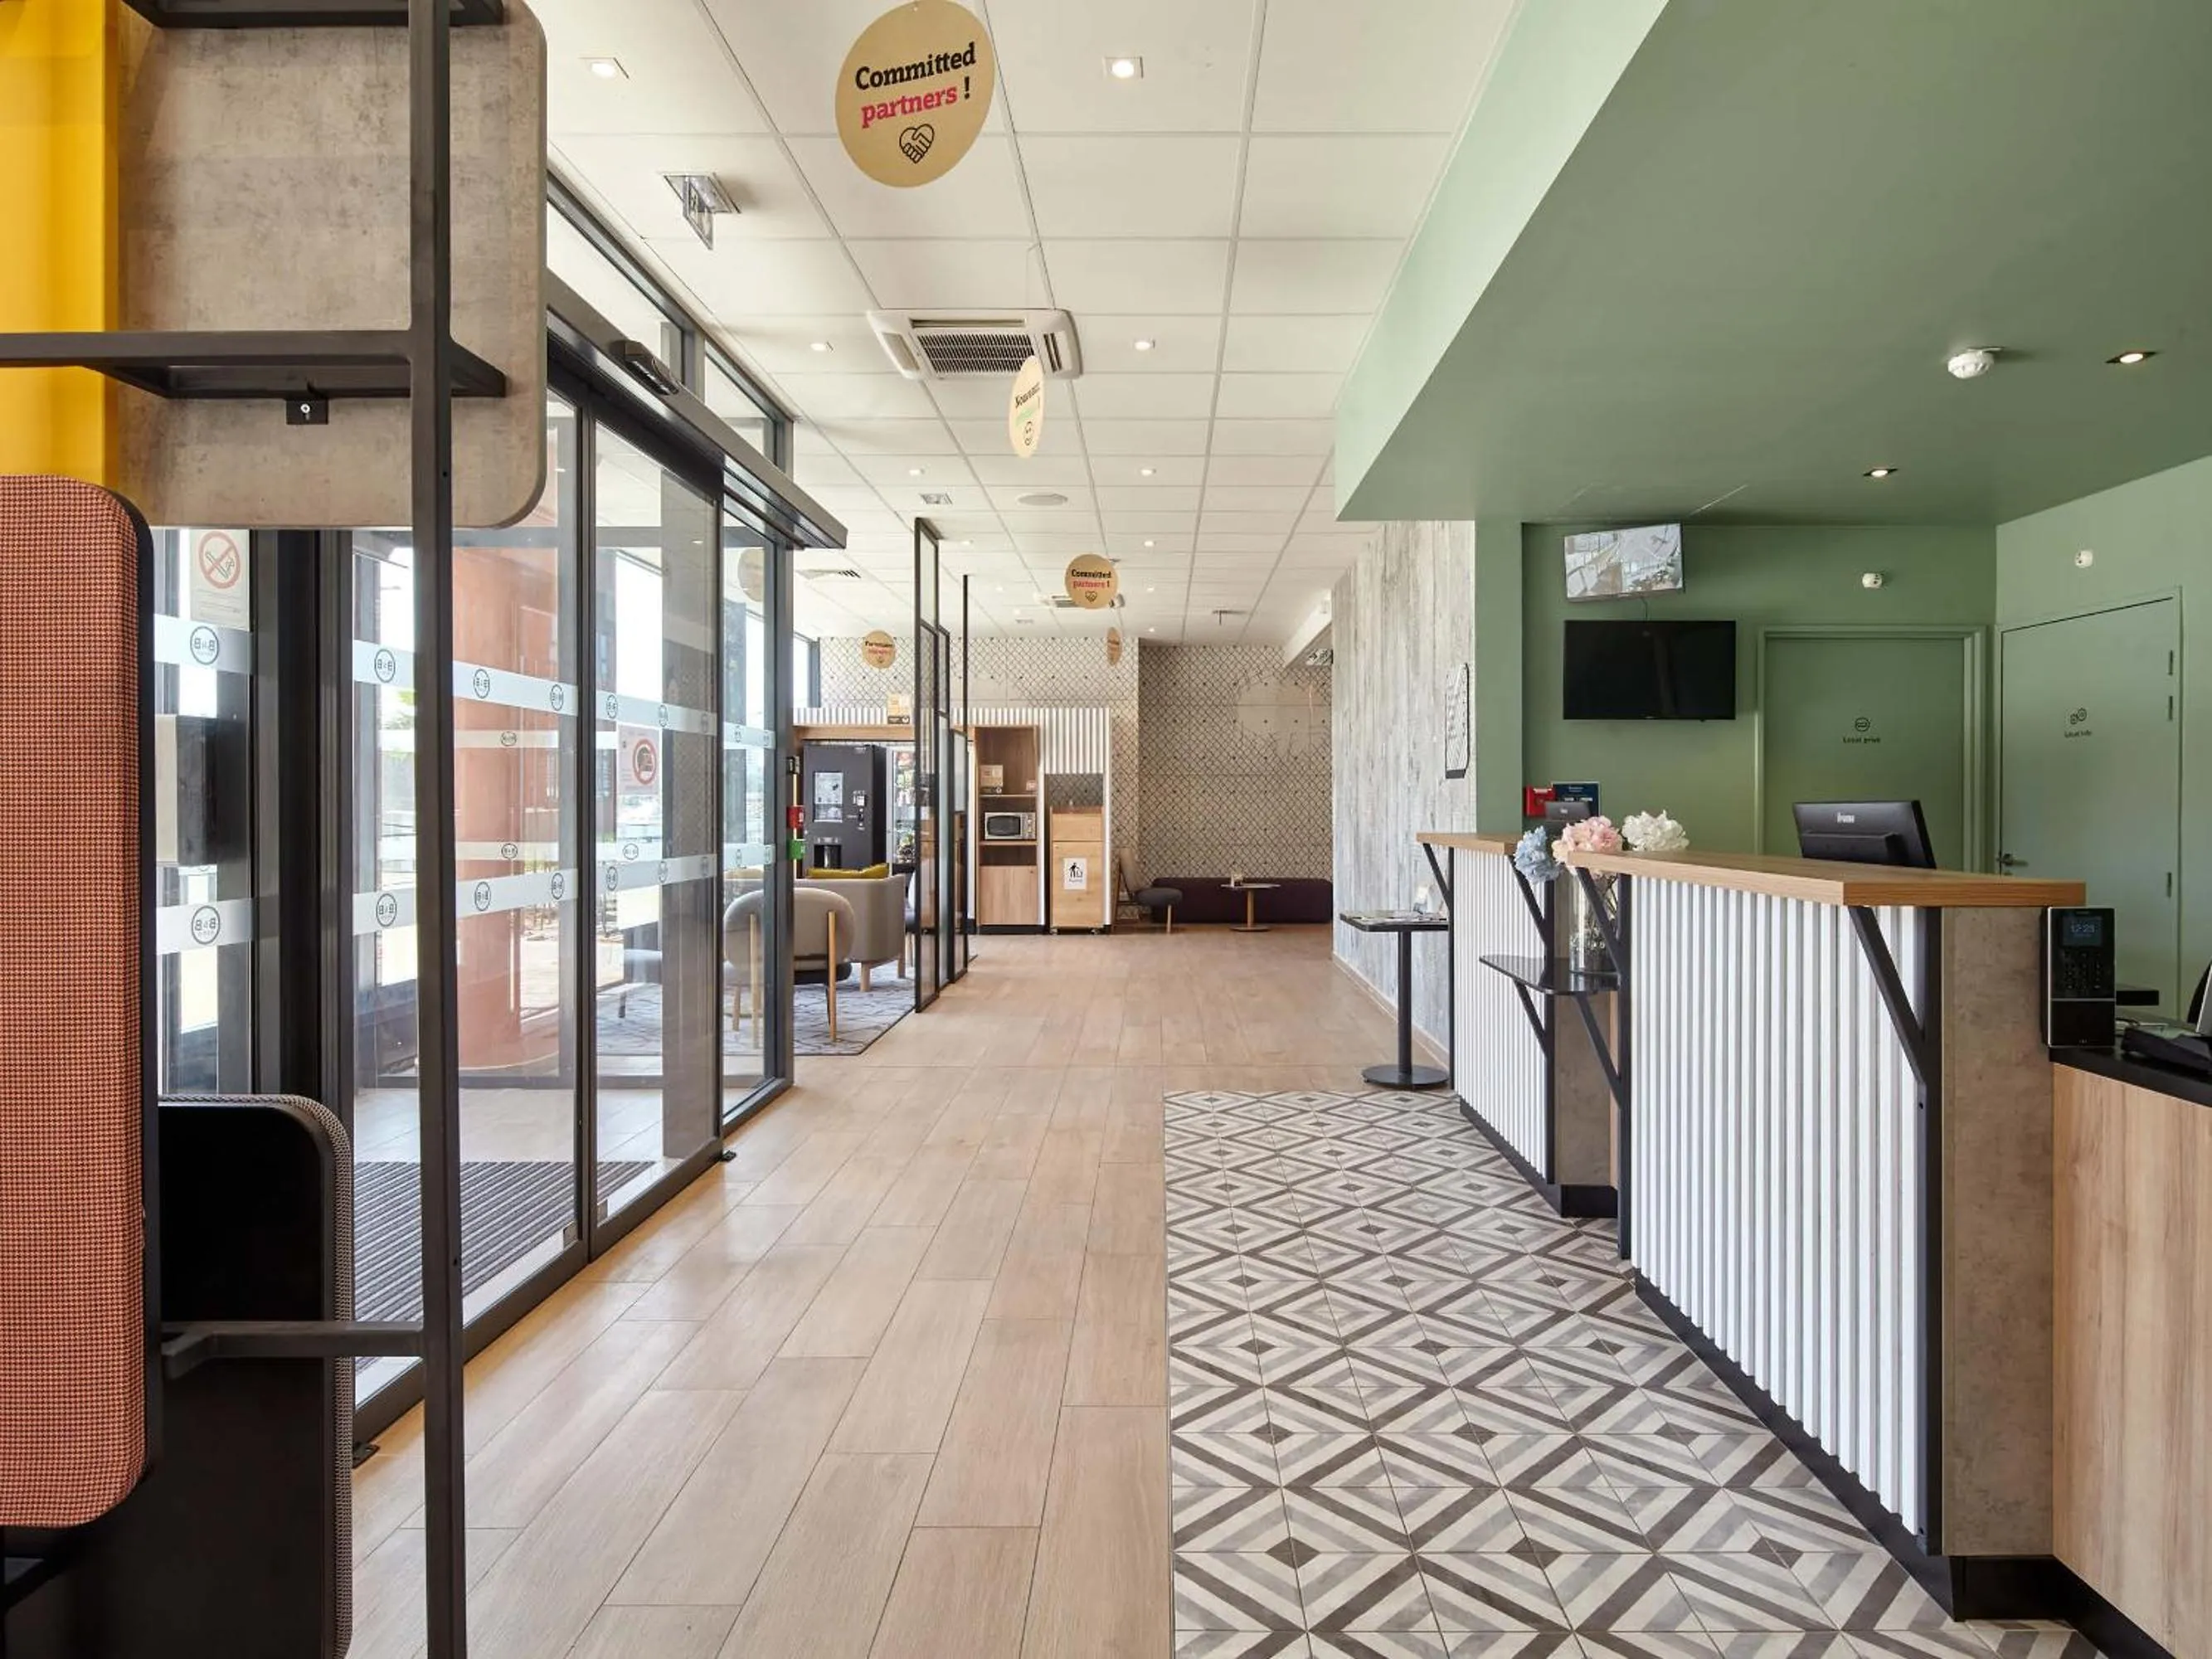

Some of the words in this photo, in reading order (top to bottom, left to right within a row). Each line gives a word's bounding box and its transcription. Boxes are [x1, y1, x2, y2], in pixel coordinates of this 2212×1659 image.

[854, 41, 976, 90] Committed
[860, 85, 958, 129] partners
[964, 75, 970, 100] !
